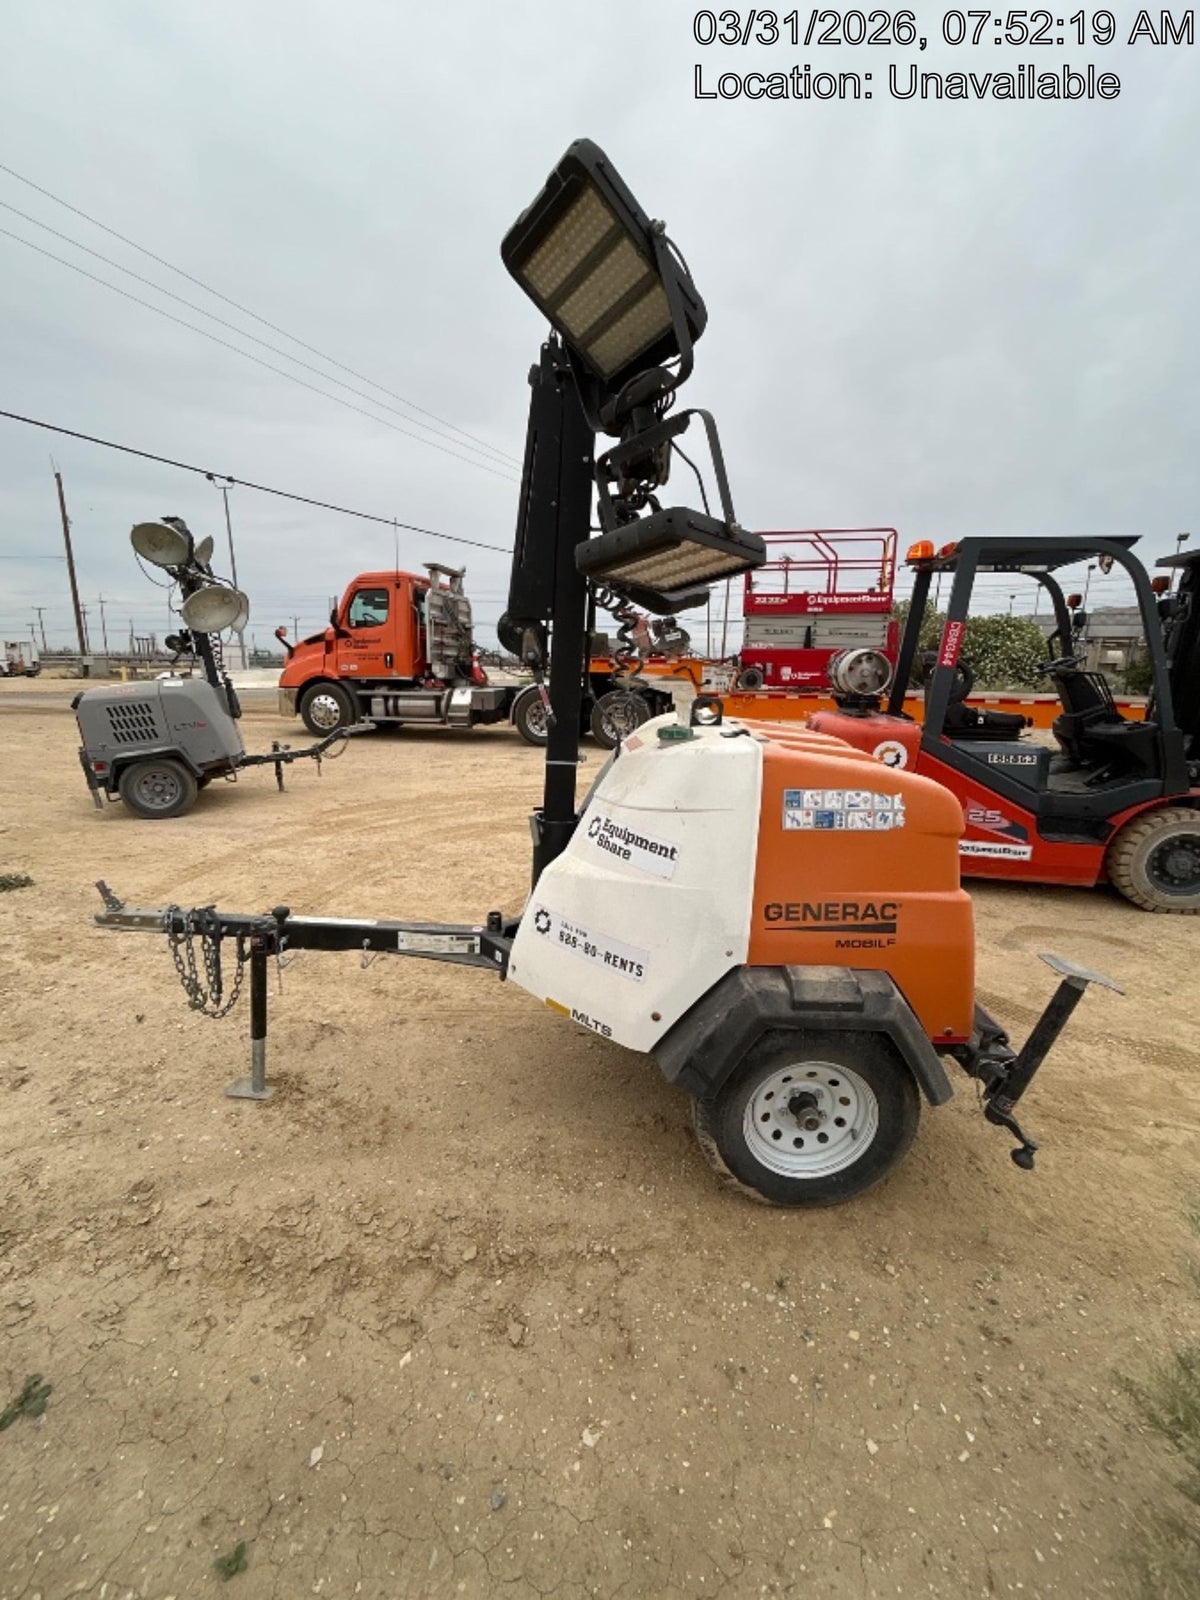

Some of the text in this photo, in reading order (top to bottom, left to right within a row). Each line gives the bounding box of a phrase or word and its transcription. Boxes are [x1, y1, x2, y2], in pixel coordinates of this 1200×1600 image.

[968, 808, 1002, 823] 25
[596, 833, 632, 860] Share
[602, 817, 679, 861] Equipment
[764, 903, 898, 922] GENERAC
[571, 1008, 613, 1037] MLTS
